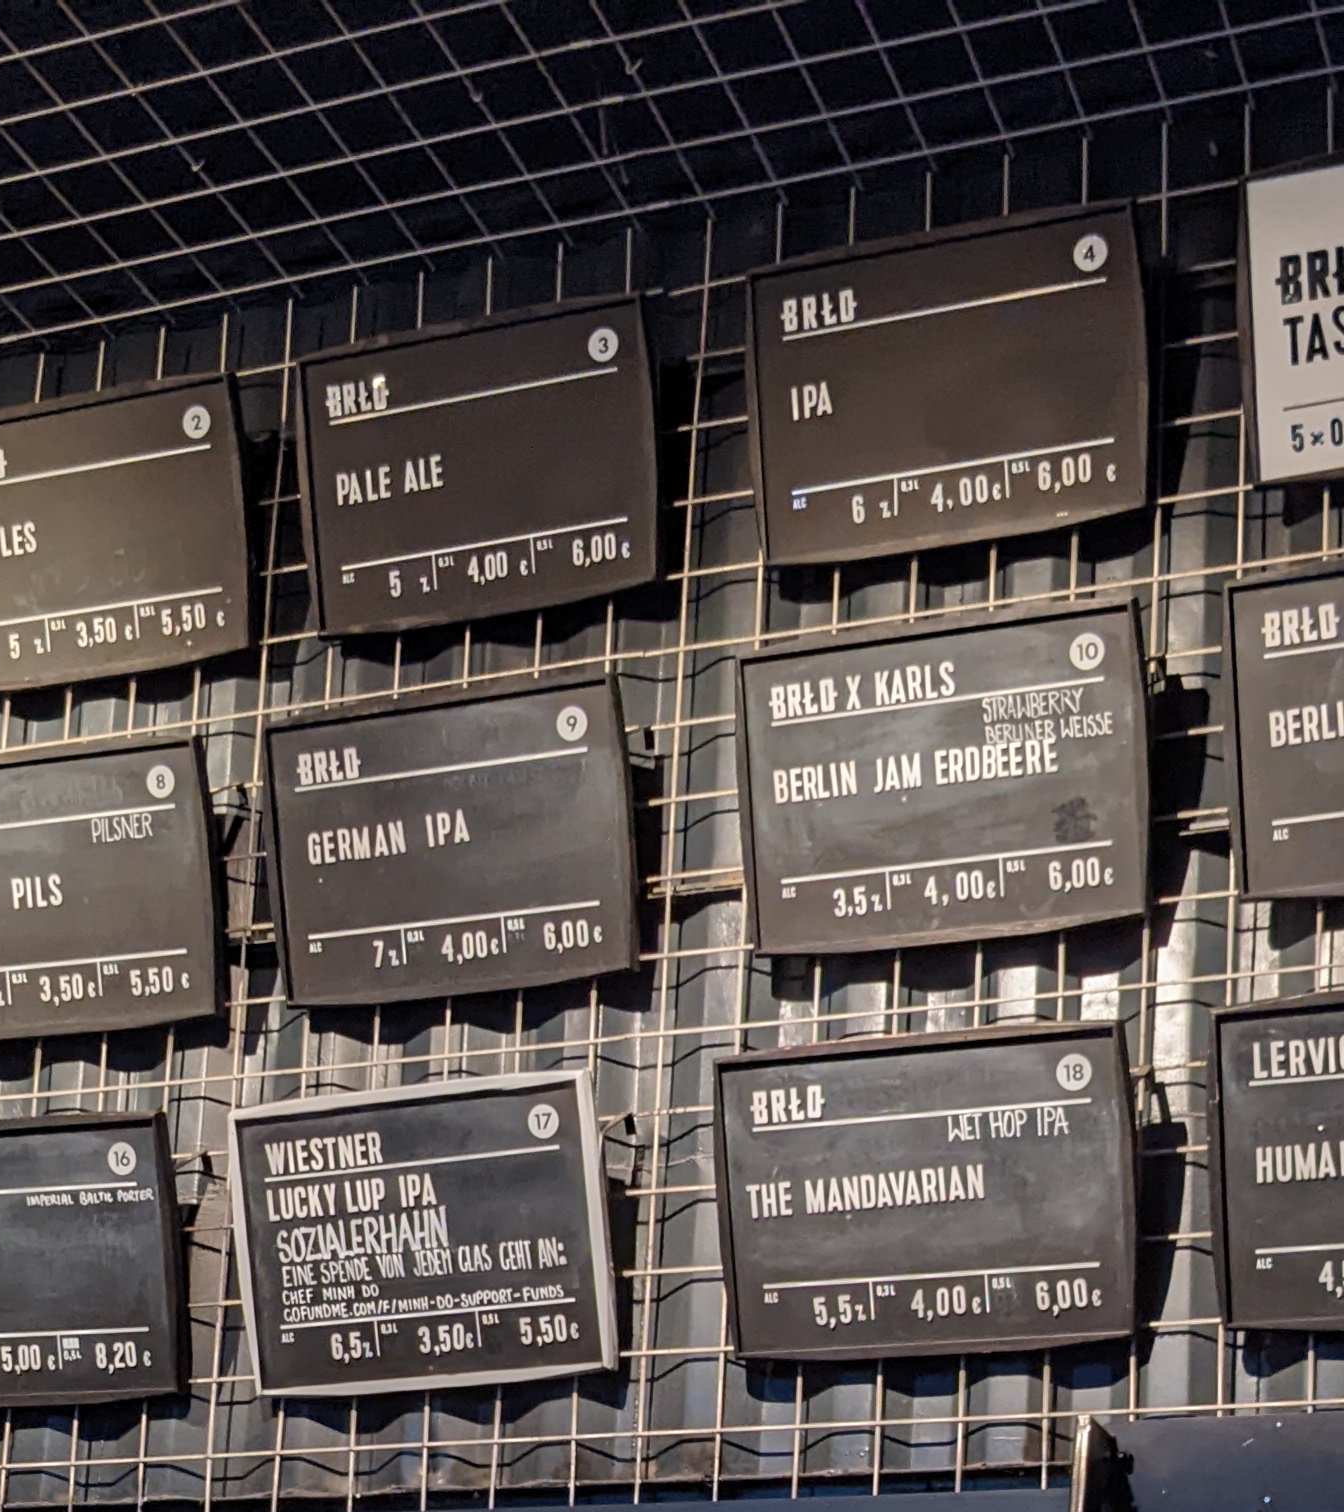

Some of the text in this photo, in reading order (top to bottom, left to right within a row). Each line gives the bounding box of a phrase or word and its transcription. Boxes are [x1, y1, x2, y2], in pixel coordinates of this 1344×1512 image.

[790, 381, 833, 421] IPA
[336, 454, 444, 506] PALE ALE
[847, 641, 1099, 711] X KARLS 10
[982, 687, 1085, 724] STRAWBERRY
[985, 711, 1114, 745] BERLINER WEISSE
[773, 738, 1059, 804] BERLIN JAM ERDBEERE
[91, 813, 153, 844] PILSNER
[308, 809, 471, 866] GERMAN IPA
[11, 874, 64, 910] PILS
[1063, 1063, 1084, 1082] 18
[265, 1112, 553, 1175] WIESTNER 17
[947, 1106, 1069, 1143] WET HOP IPA
[117, 1188, 155, 1202] PORTER
[267, 1173, 438, 1223] LUCKY LUP IPA
[746, 1164, 985, 1220] THE MANDAVARIAN
[277, 1206, 450, 1263] SOZIALERHAHN
[282, 1263, 317, 1288] EINE
[321, 1257, 373, 1283] SPENDE
[379, 1254, 406, 1279] VON
[413, 1248, 453, 1277] JEDEM
[459, 1244, 492, 1273] GLAS
[499, 1240, 533, 1271] GEHT
[282, 1284, 379, 1305] CHEF MINH DO
